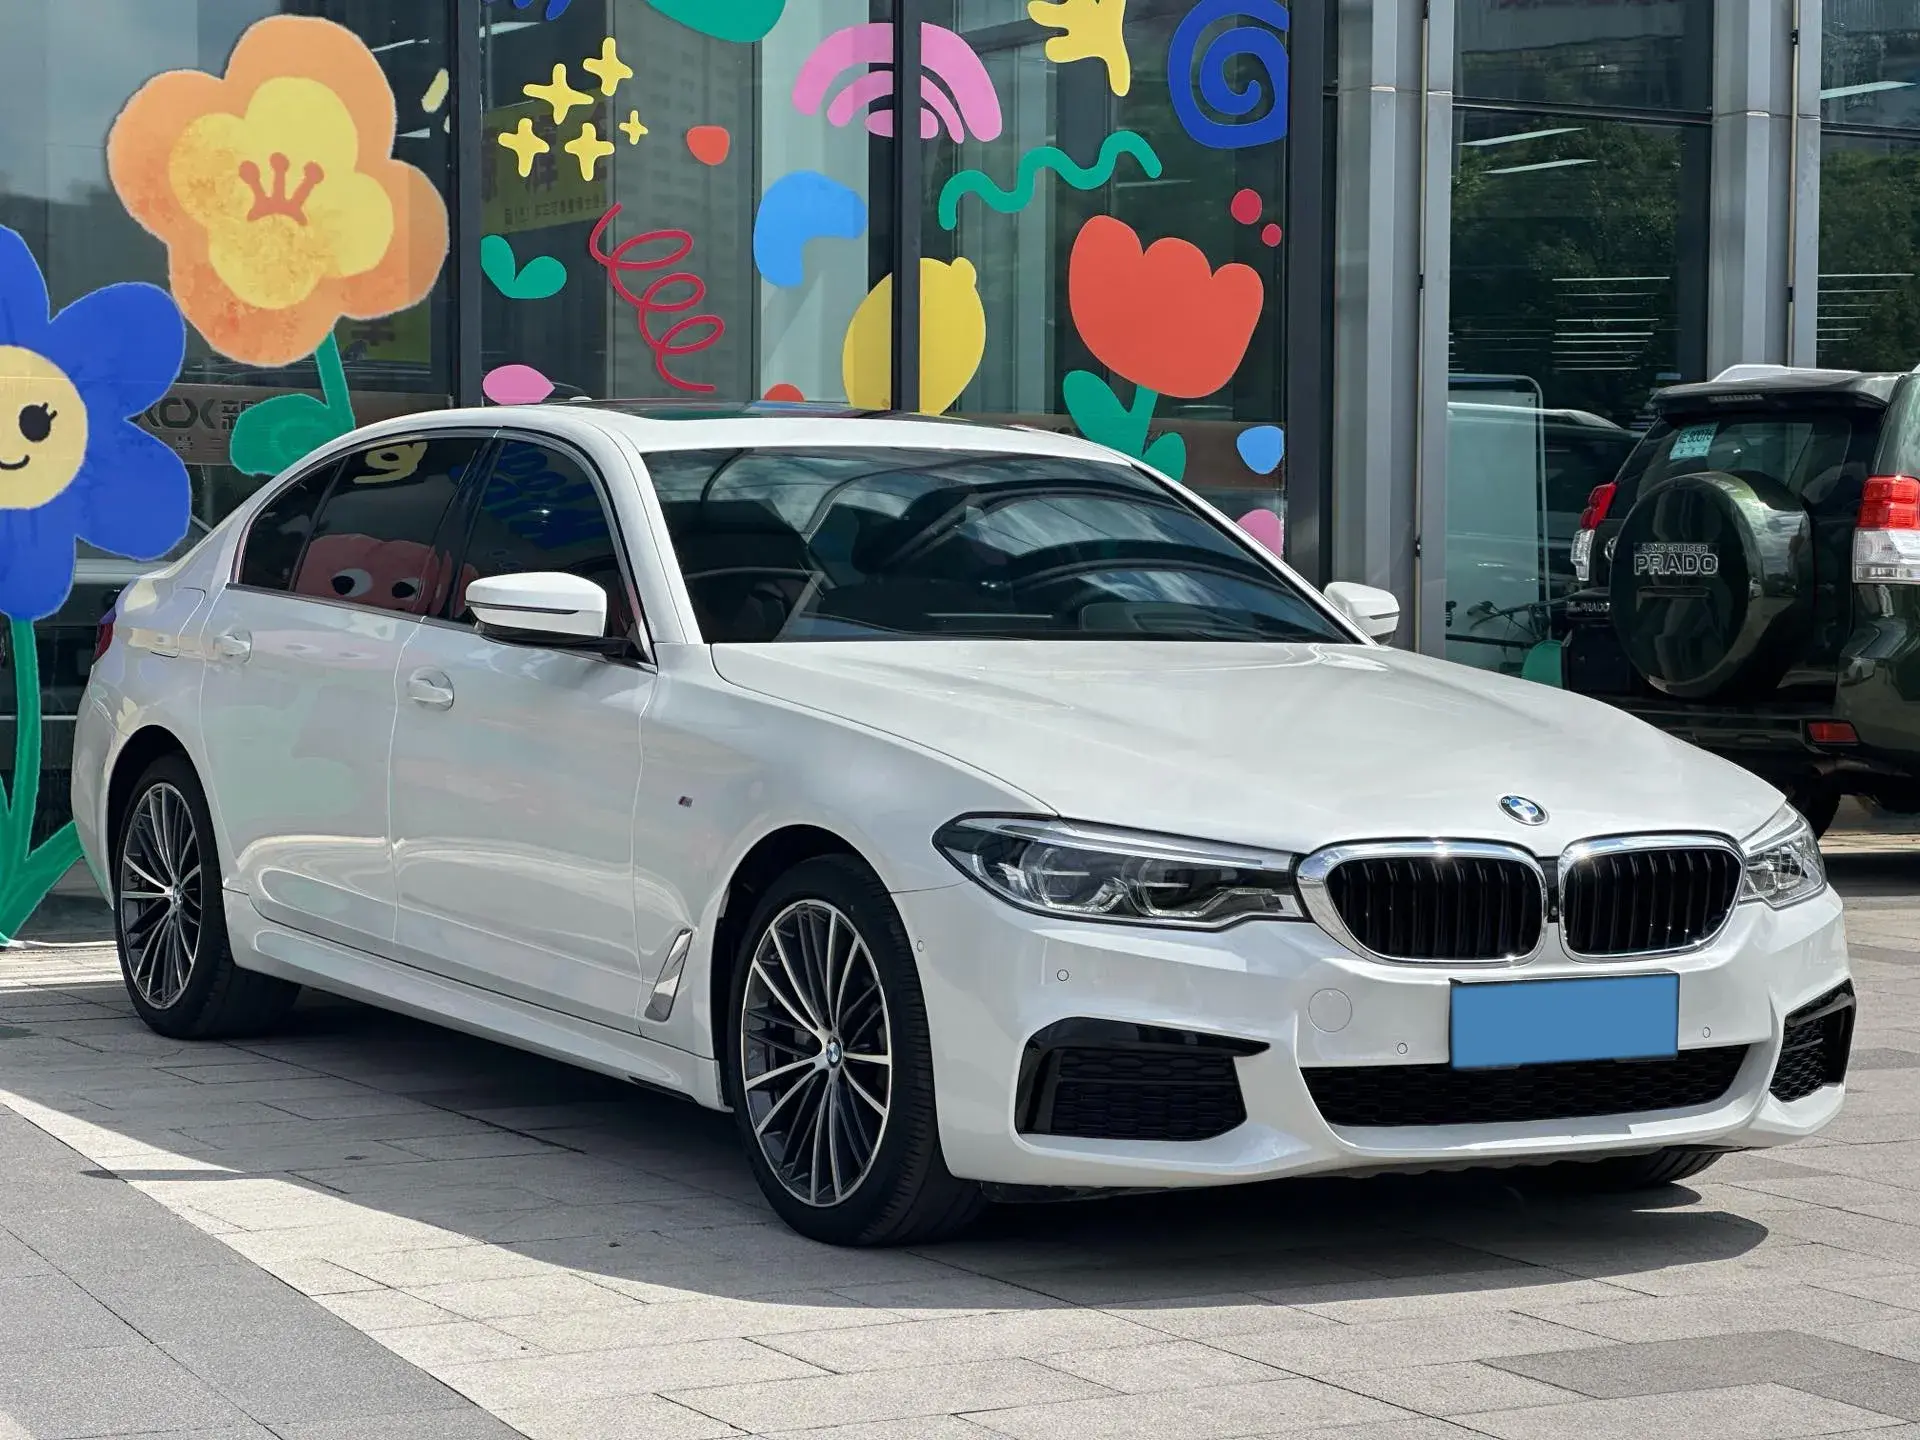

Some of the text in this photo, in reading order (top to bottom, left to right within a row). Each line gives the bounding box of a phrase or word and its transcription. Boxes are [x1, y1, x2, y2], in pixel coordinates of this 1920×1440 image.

[1641, 543, 1709, 554] LAND CRUISER
[1633, 553, 1719, 576] PRADO
